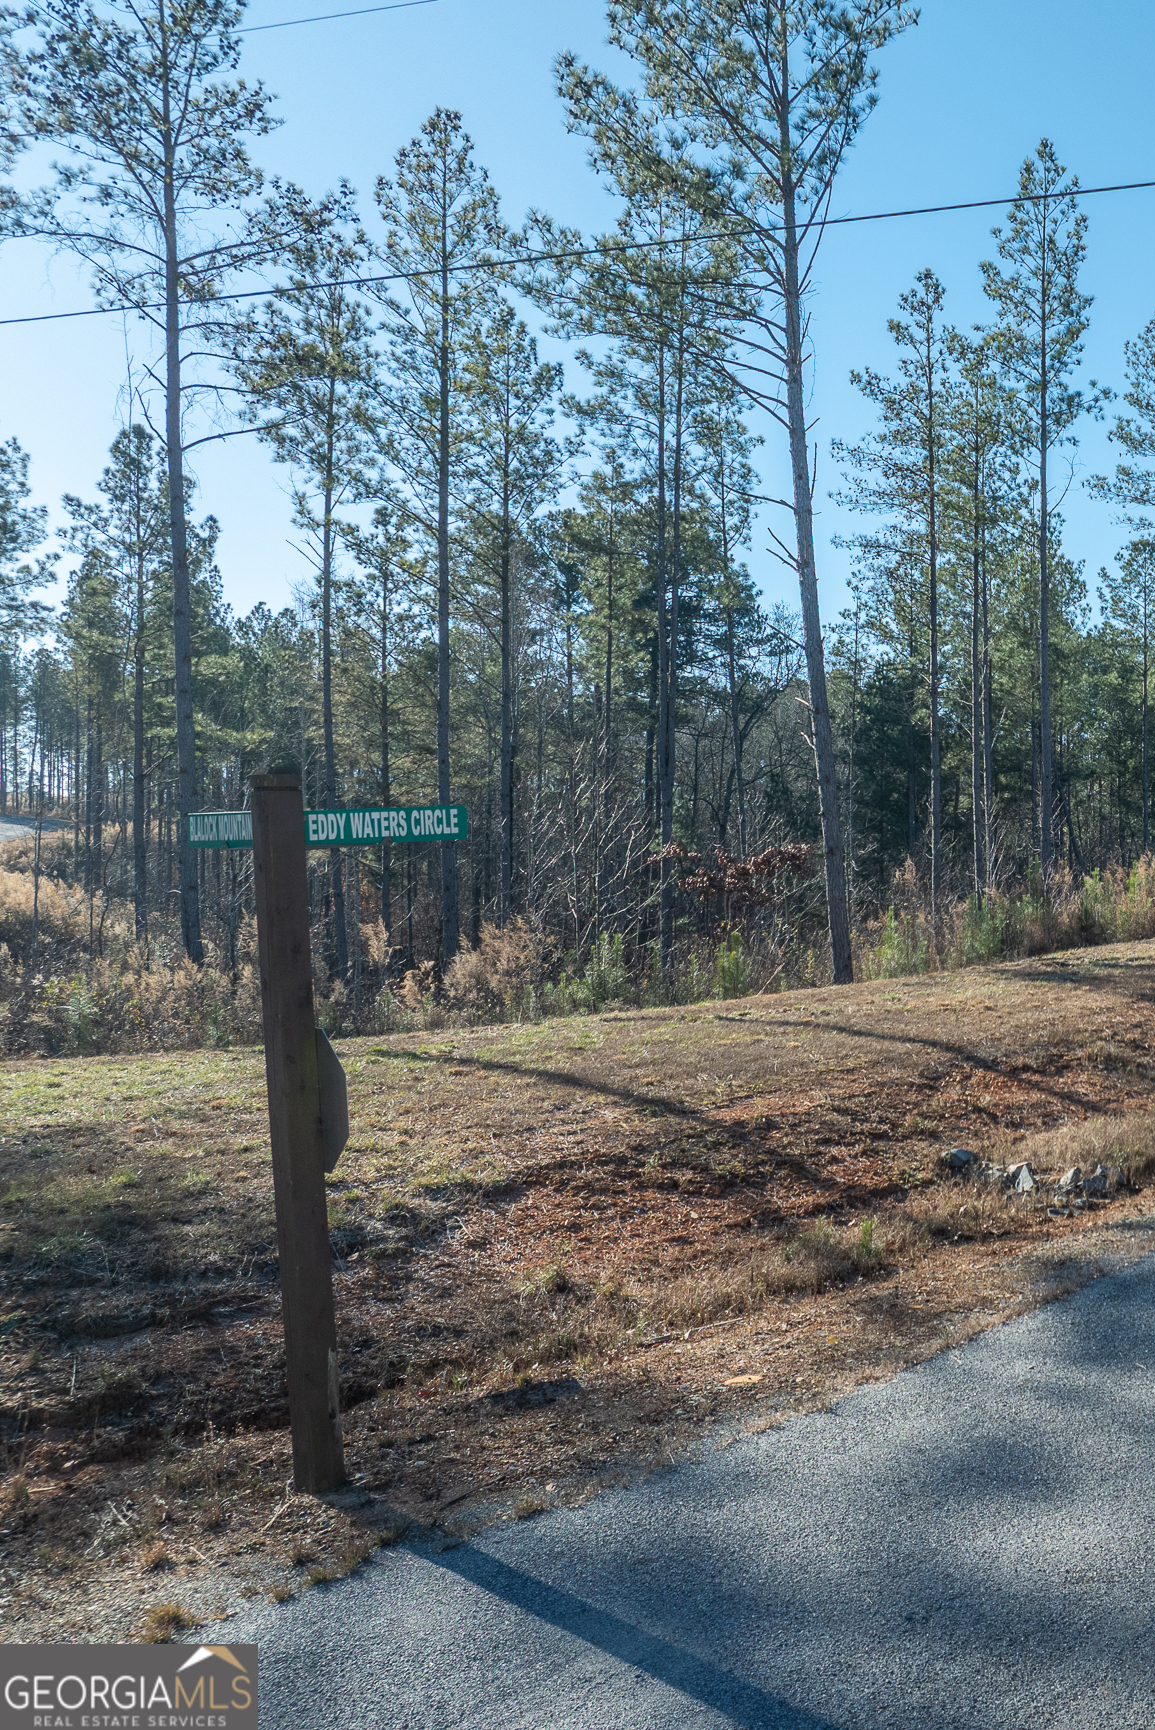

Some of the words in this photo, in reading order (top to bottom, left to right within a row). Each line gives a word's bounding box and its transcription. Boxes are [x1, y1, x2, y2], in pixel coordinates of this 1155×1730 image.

[189, 815, 218, 842] BLALOCK
[218, 814, 254, 841] MOUNTAIN
[304, 812, 347, 841] EDDY
[349, 809, 408, 839] WATERS
[410, 808, 459, 836] CIRCLE
